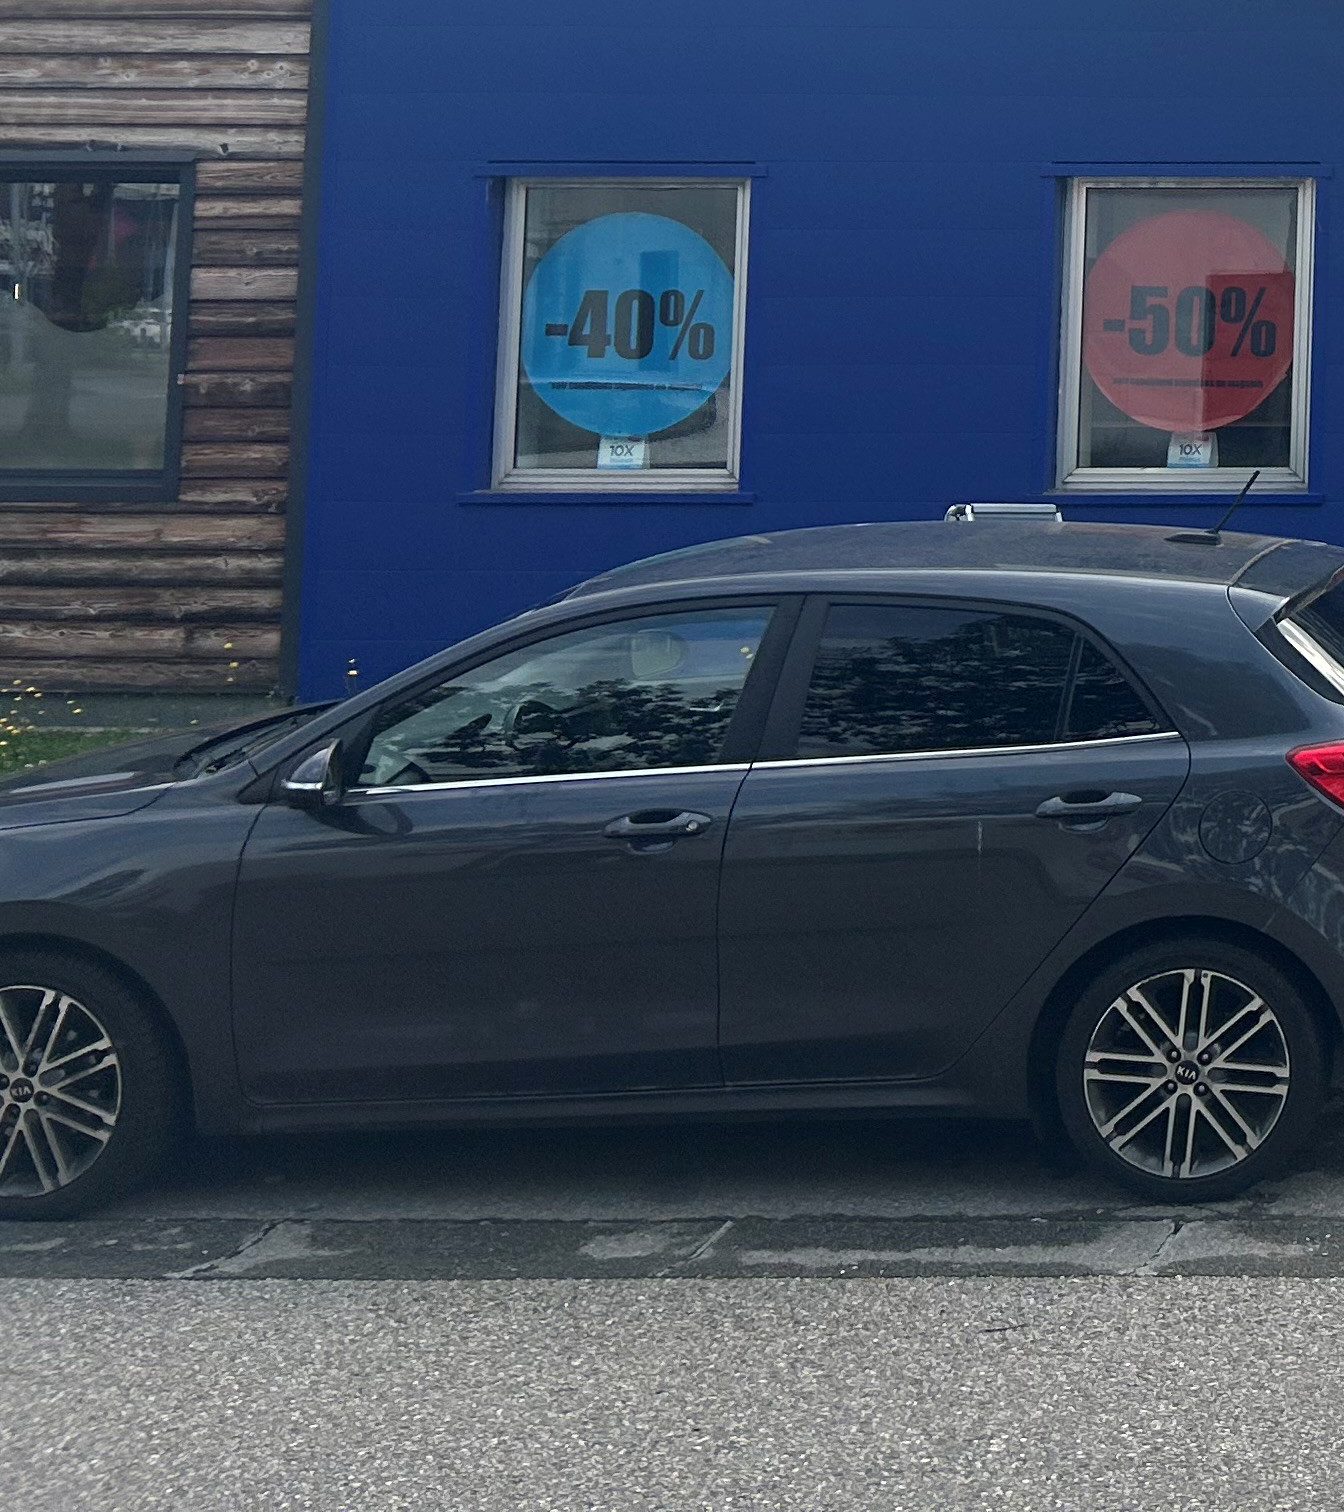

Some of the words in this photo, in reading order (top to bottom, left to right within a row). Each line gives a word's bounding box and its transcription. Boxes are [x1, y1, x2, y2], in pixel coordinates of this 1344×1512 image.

[544, 289, 716, 361] -40%
[1102, 285, 1277, 358] -50%
[609, 444, 635, 457] 10X
[1179, 443, 1202, 456] 10X
[1176, 1065, 1196, 1080] KIA
